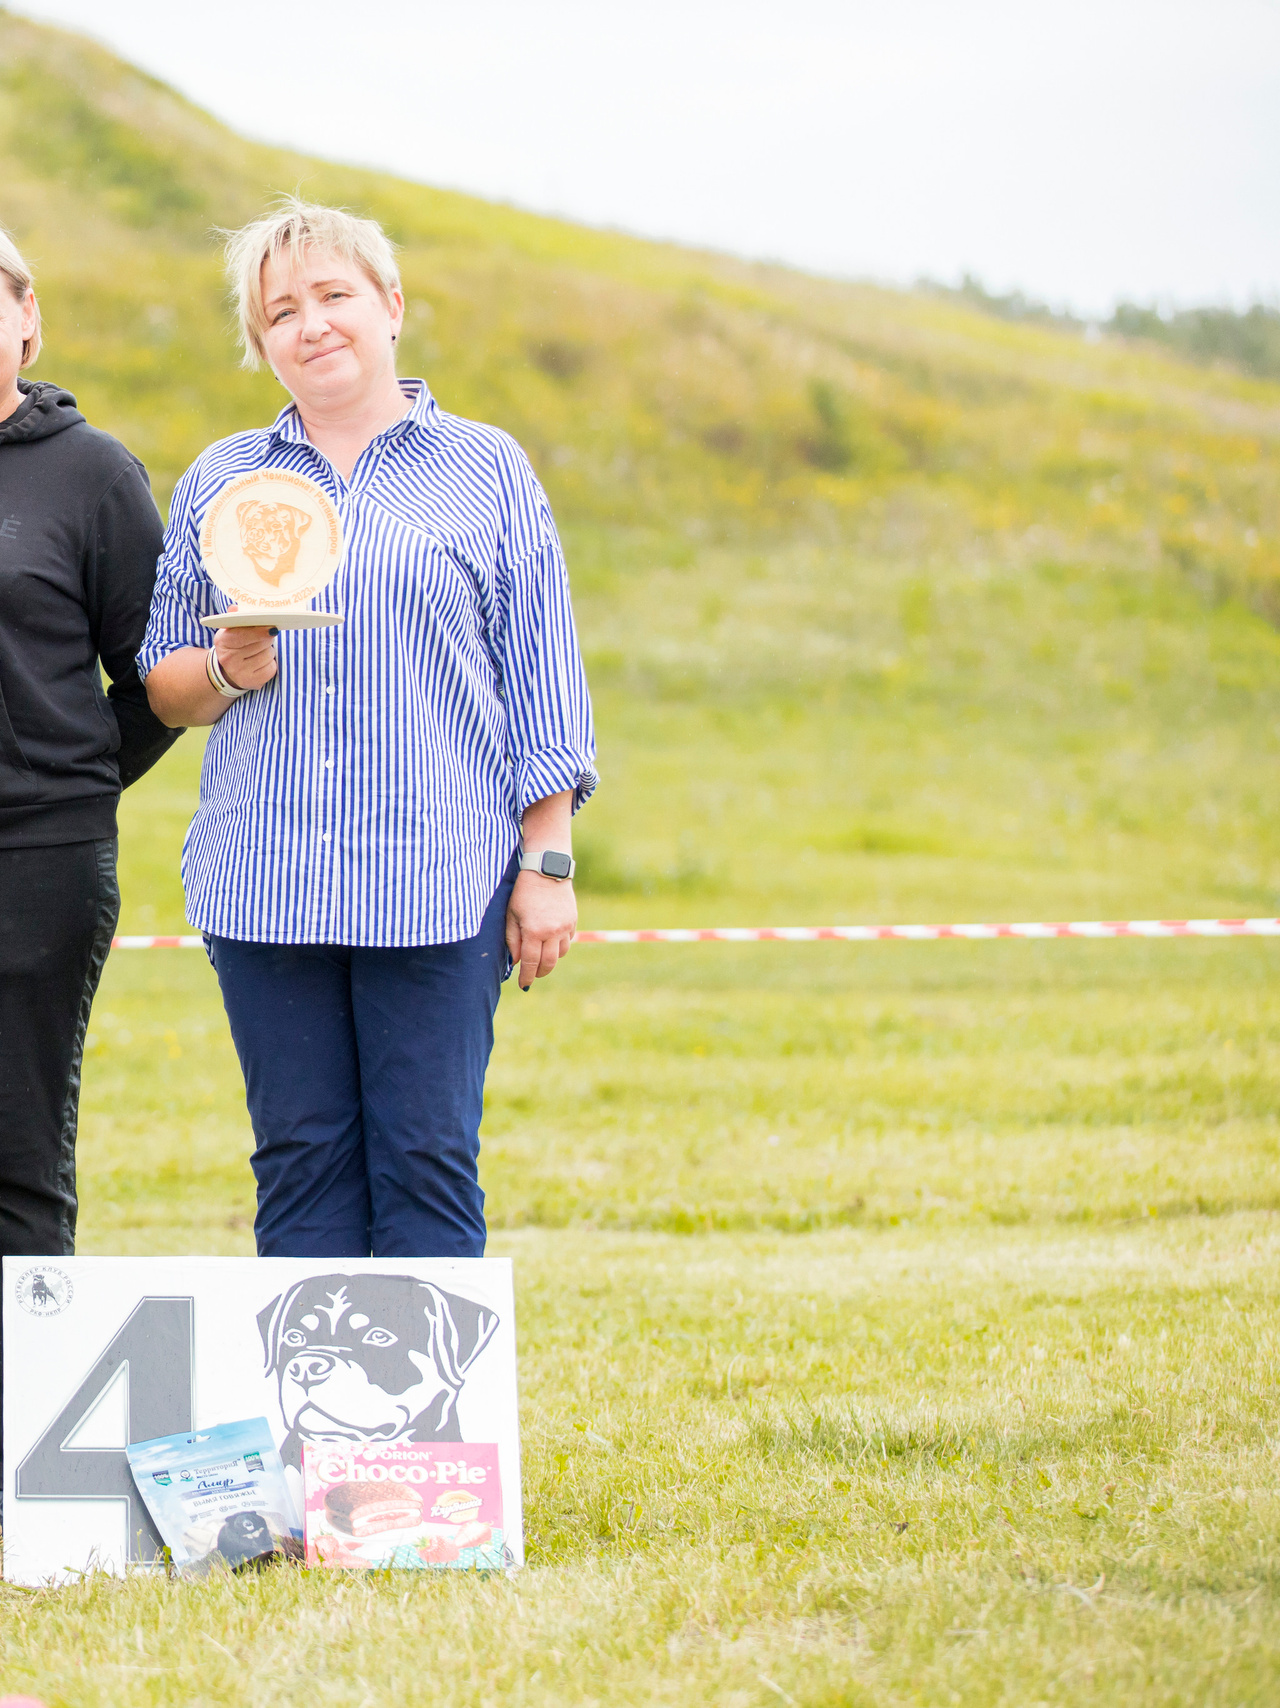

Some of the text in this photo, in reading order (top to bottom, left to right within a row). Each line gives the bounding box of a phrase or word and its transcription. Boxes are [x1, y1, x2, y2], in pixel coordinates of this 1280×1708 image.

[203, 473, 260, 548] Межрегиональный
[262, 471, 316, 493] Чемпионат
[314, 491, 338, 555] Ротвейлеров
[258, 597, 292, 608] Рязани
[16, 1296, 195, 1564] 4
[380, 1451, 430, 1461] ORION
